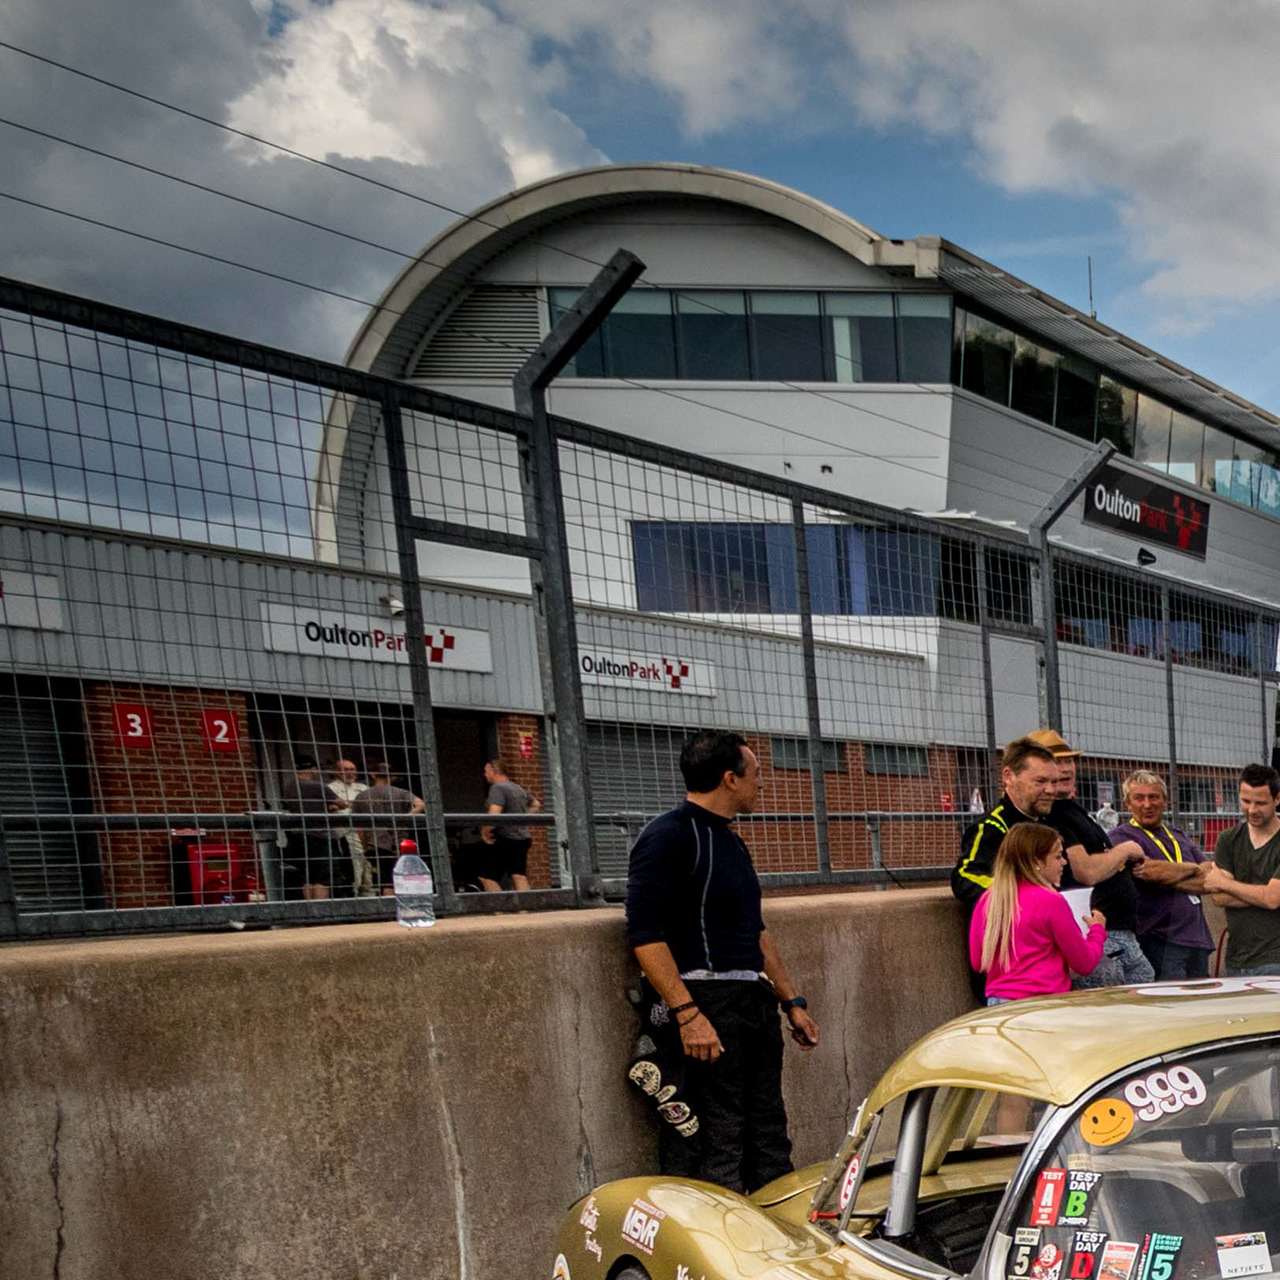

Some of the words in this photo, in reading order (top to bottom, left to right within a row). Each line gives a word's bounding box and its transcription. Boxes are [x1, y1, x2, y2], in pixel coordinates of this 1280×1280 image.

[1094, 484, 1168, 532] OultonPark
[305, 621, 409, 651] OultonPar
[582, 656, 661, 681] OultonPark
[126, 713, 144, 737] 3
[213, 720, 230, 743] 2
[1124, 1065, 1207, 1122] 999
[1042, 1172, 1064, 1180] TEST
[1069, 1171, 1101, 1182] TEST
[1069, 1181, 1094, 1191] DAY
[1041, 1183, 1055, 1206] A
[1065, 1191, 1088, 1216] B
[622, 1206, 660, 1249] MSVR
[1075, 1231, 1106, 1242] TEST
[1075, 1242, 1100, 1252] DAY
[1014, 1246, 1031, 1275] 5
[1070, 1252, 1095, 1278] D
[1151, 1253, 1174, 1280] 5
